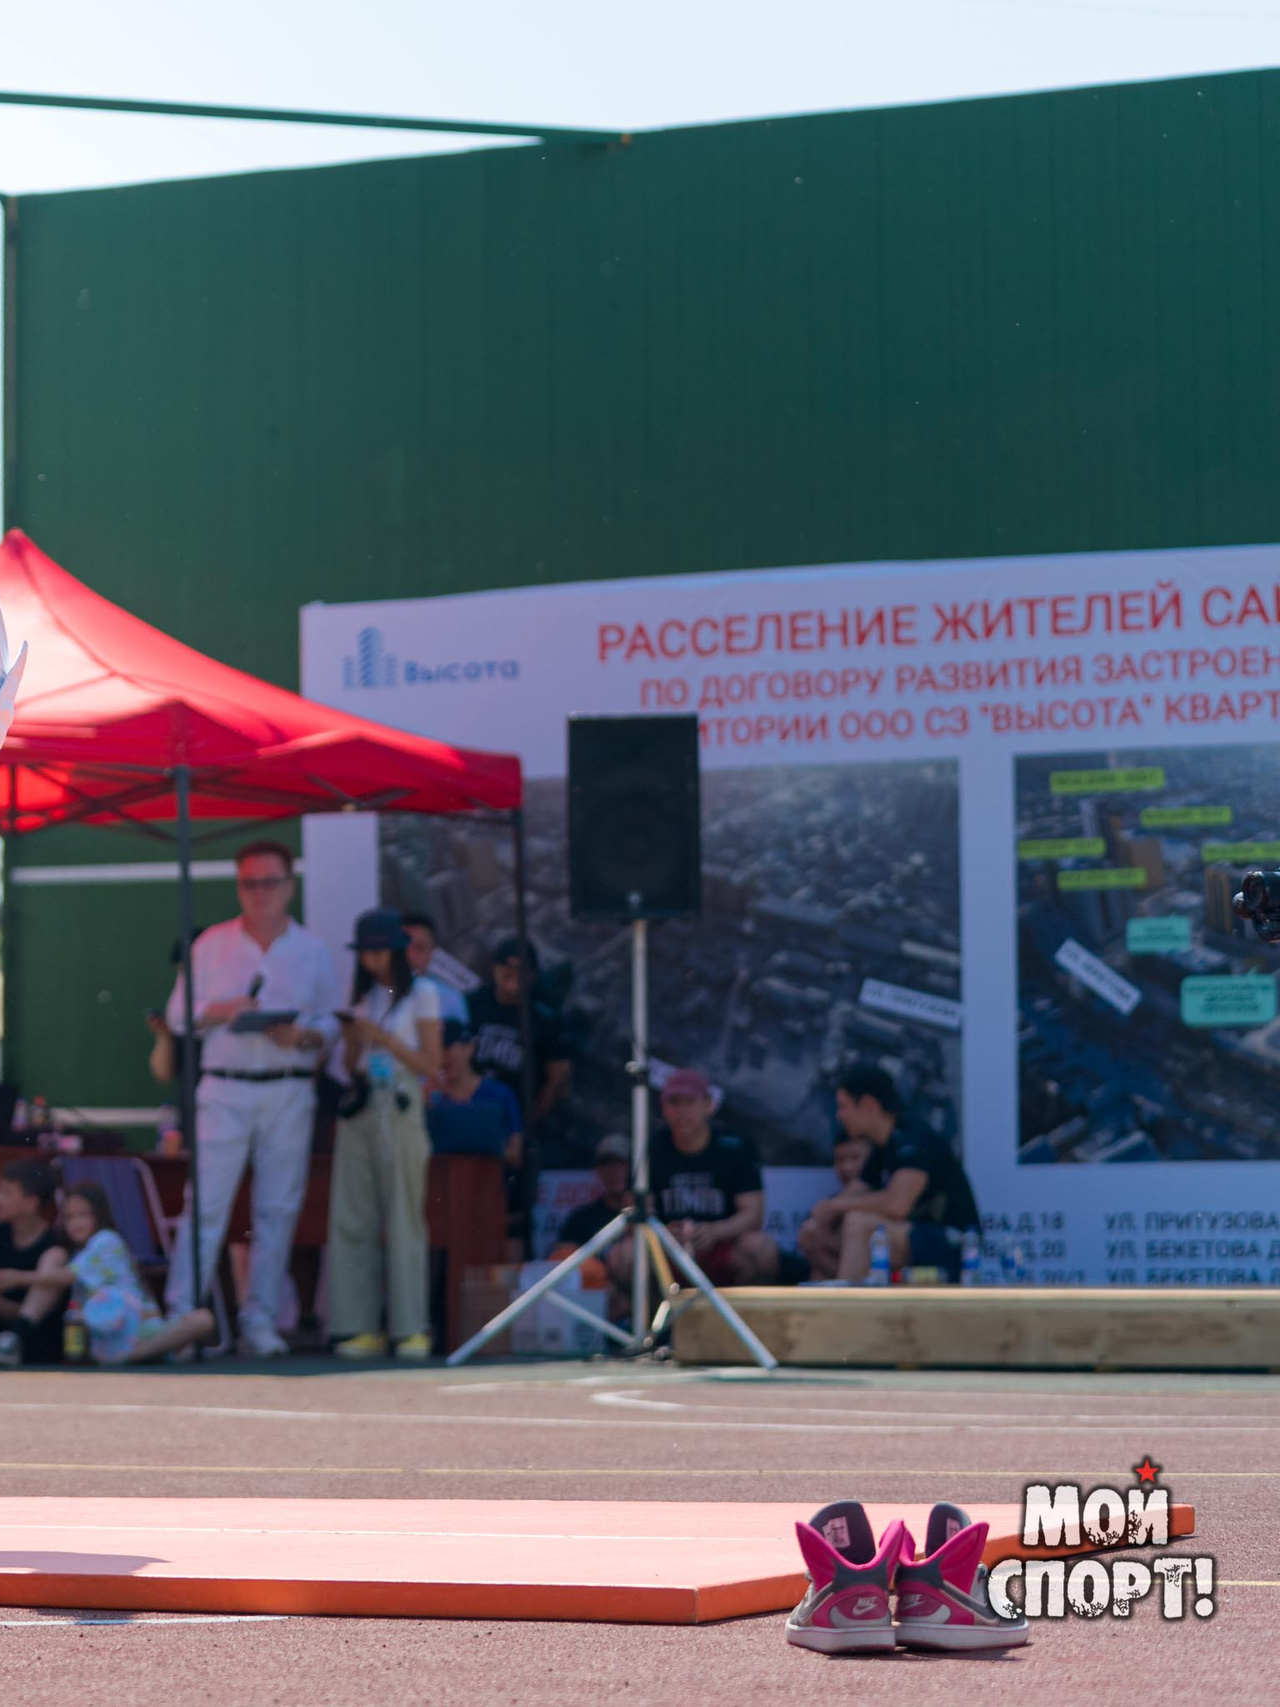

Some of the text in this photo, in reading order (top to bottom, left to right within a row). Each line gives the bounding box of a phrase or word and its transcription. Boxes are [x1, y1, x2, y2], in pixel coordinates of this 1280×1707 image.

[597, 605, 918, 663] РАССЕЛЕНИЕ
[932, 580, 1182, 643] ЖИТЕЛЕЙ
[640, 677, 690, 708] ПО
[698, 667, 885, 709] ДОГОВОРУ
[895, 654, 1083, 693] РАЗВИТИЯ
[839, 708, 916, 740] ООО
[924, 705, 969, 737] СЗ
[980, 694, 1154, 733] "ВЫСОТА"
[1144, 1239, 1260, 1259] БЕКЕТОВА
